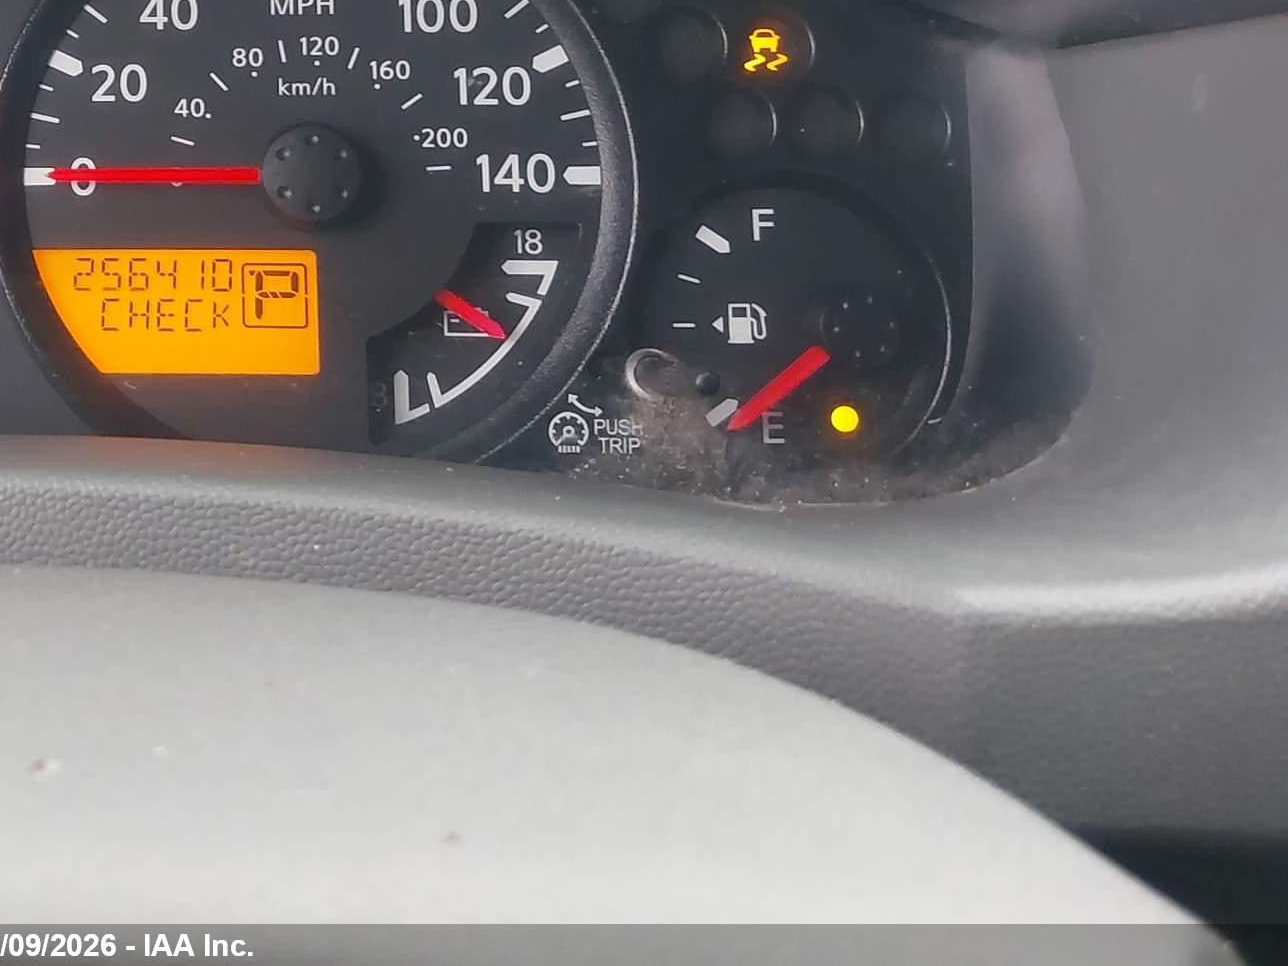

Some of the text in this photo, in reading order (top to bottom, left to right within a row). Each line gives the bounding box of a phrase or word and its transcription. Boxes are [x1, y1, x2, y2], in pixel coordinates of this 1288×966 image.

[232, 47, 263, 68] 80
[299, 36, 339, 56] 120
[91, 63, 148, 102] 20
[369, 60, 411, 80] 160
[278, 77, 336, 96] km/h
[453, 66, 531, 106] 120
[174, 98, 205, 118] 40
[421, 127, 468, 148] 200
[70, 157, 96, 196] 0
[476, 153, 556, 193] 140
[751, 208, 775, 241] F
[515, 229, 543, 255] 18
[73, 258, 233, 292] 256410
[248, 270, 299, 320] P
[101, 298, 230, 332] CHECK
[593, 418, 645, 436] PUSH
[761, 411, 786, 444] E
[598, 437, 641, 455] TRIP
